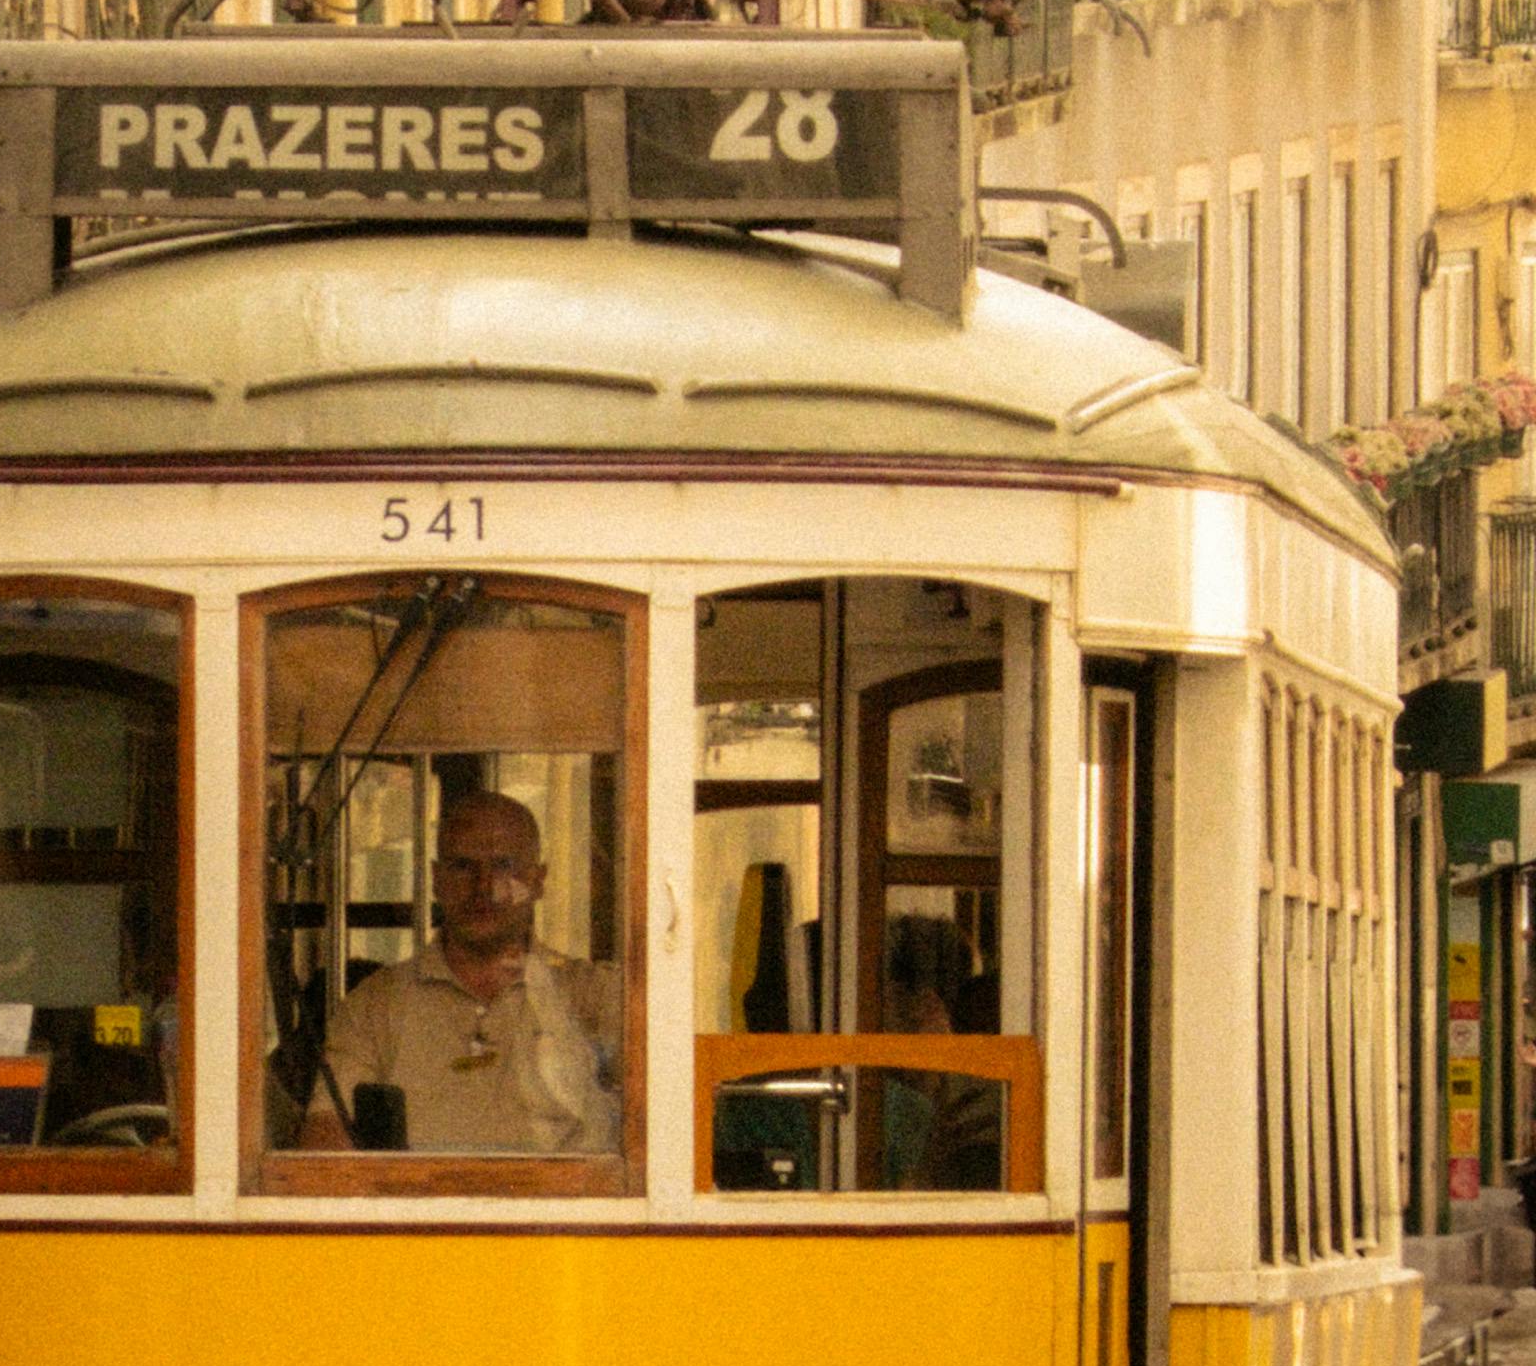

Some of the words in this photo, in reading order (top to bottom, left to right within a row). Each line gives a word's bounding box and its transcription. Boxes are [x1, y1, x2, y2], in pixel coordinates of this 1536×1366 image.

[99, 103, 545, 172] PRAZERES
[708, 90, 839, 163] 28
[381, 497, 484, 542] 541
